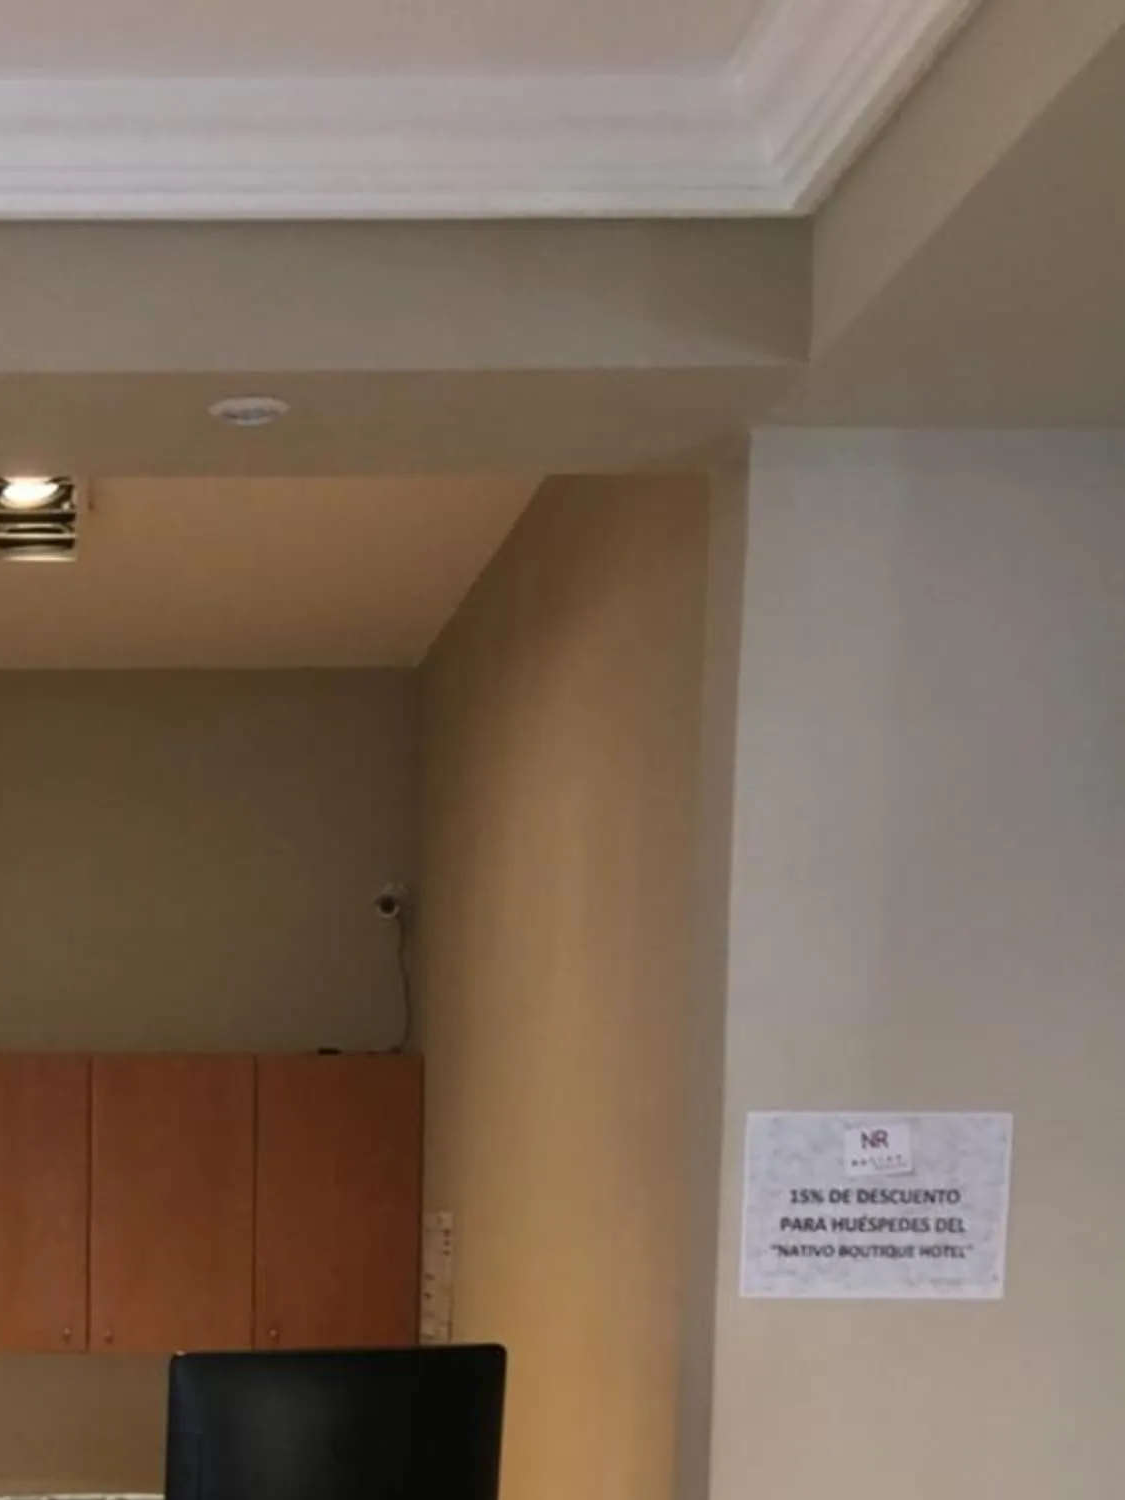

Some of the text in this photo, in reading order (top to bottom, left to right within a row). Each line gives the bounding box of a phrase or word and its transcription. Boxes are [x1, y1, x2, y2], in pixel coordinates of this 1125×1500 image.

[861, 1129, 889, 1149] NR
[789, 1189, 961, 1205] 15% DE DESCUENTO
[780, 1214, 967, 1232] PARA HUÉSPEDES DEL
[839, 1245, 916, 1259] BOUTIQUE
